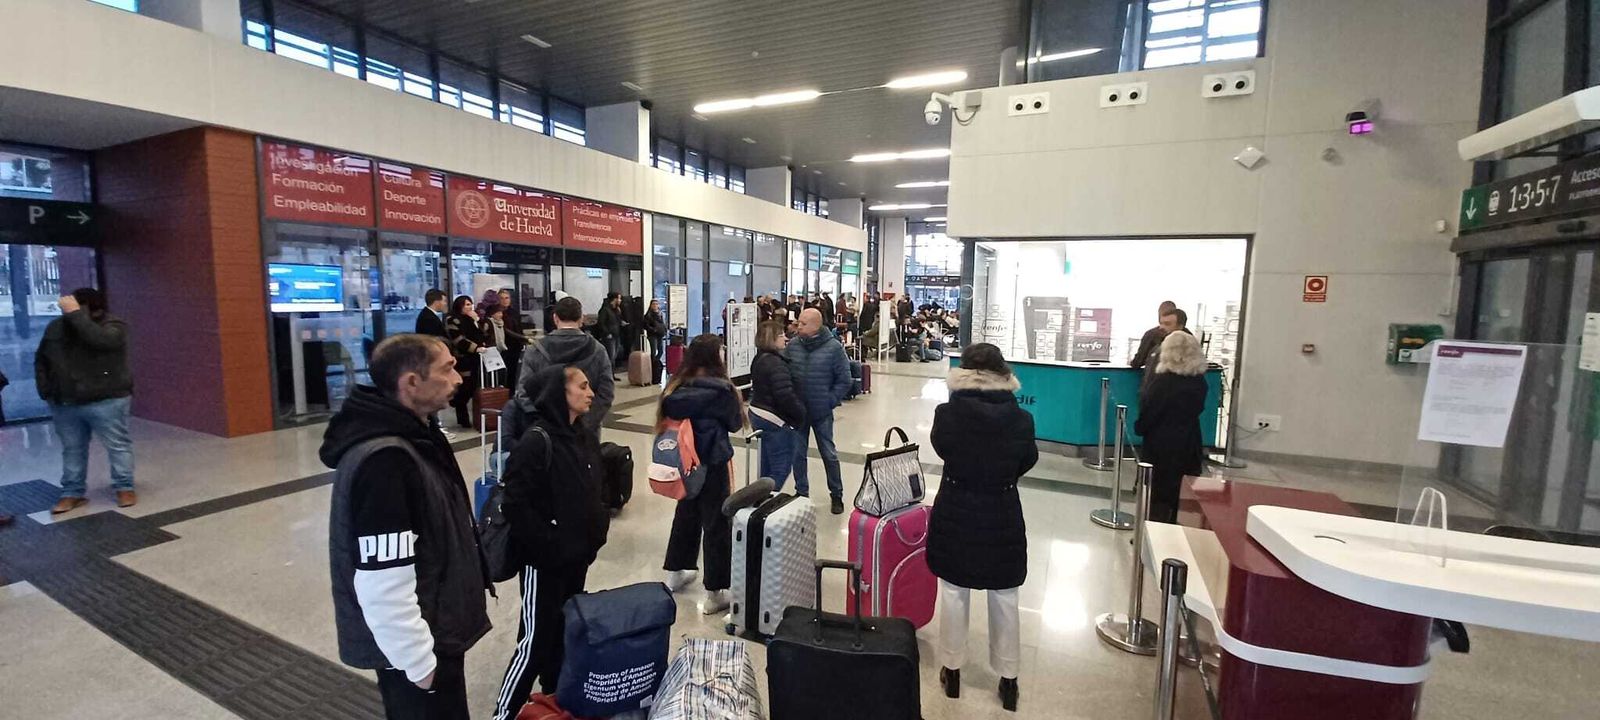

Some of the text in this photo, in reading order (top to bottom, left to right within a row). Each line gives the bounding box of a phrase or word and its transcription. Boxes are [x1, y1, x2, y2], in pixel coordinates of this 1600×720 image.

[272, 172, 345, 194] Formación
[273, 194, 367, 216] Empleabilidad
[384, 189, 427, 206] Deporte
[28, 205, 46, 225] P
[385, 208, 442, 224] Innovación
[493, 198, 556, 220] Universidad
[500, 215, 553, 237] de Huelva
[1015, 394, 1037, 405] dif
[588, 671, 619, 680] Property
[629, 662, 655, 673] Amazon
[583, 672, 657, 691] Eigentum von Amazon
